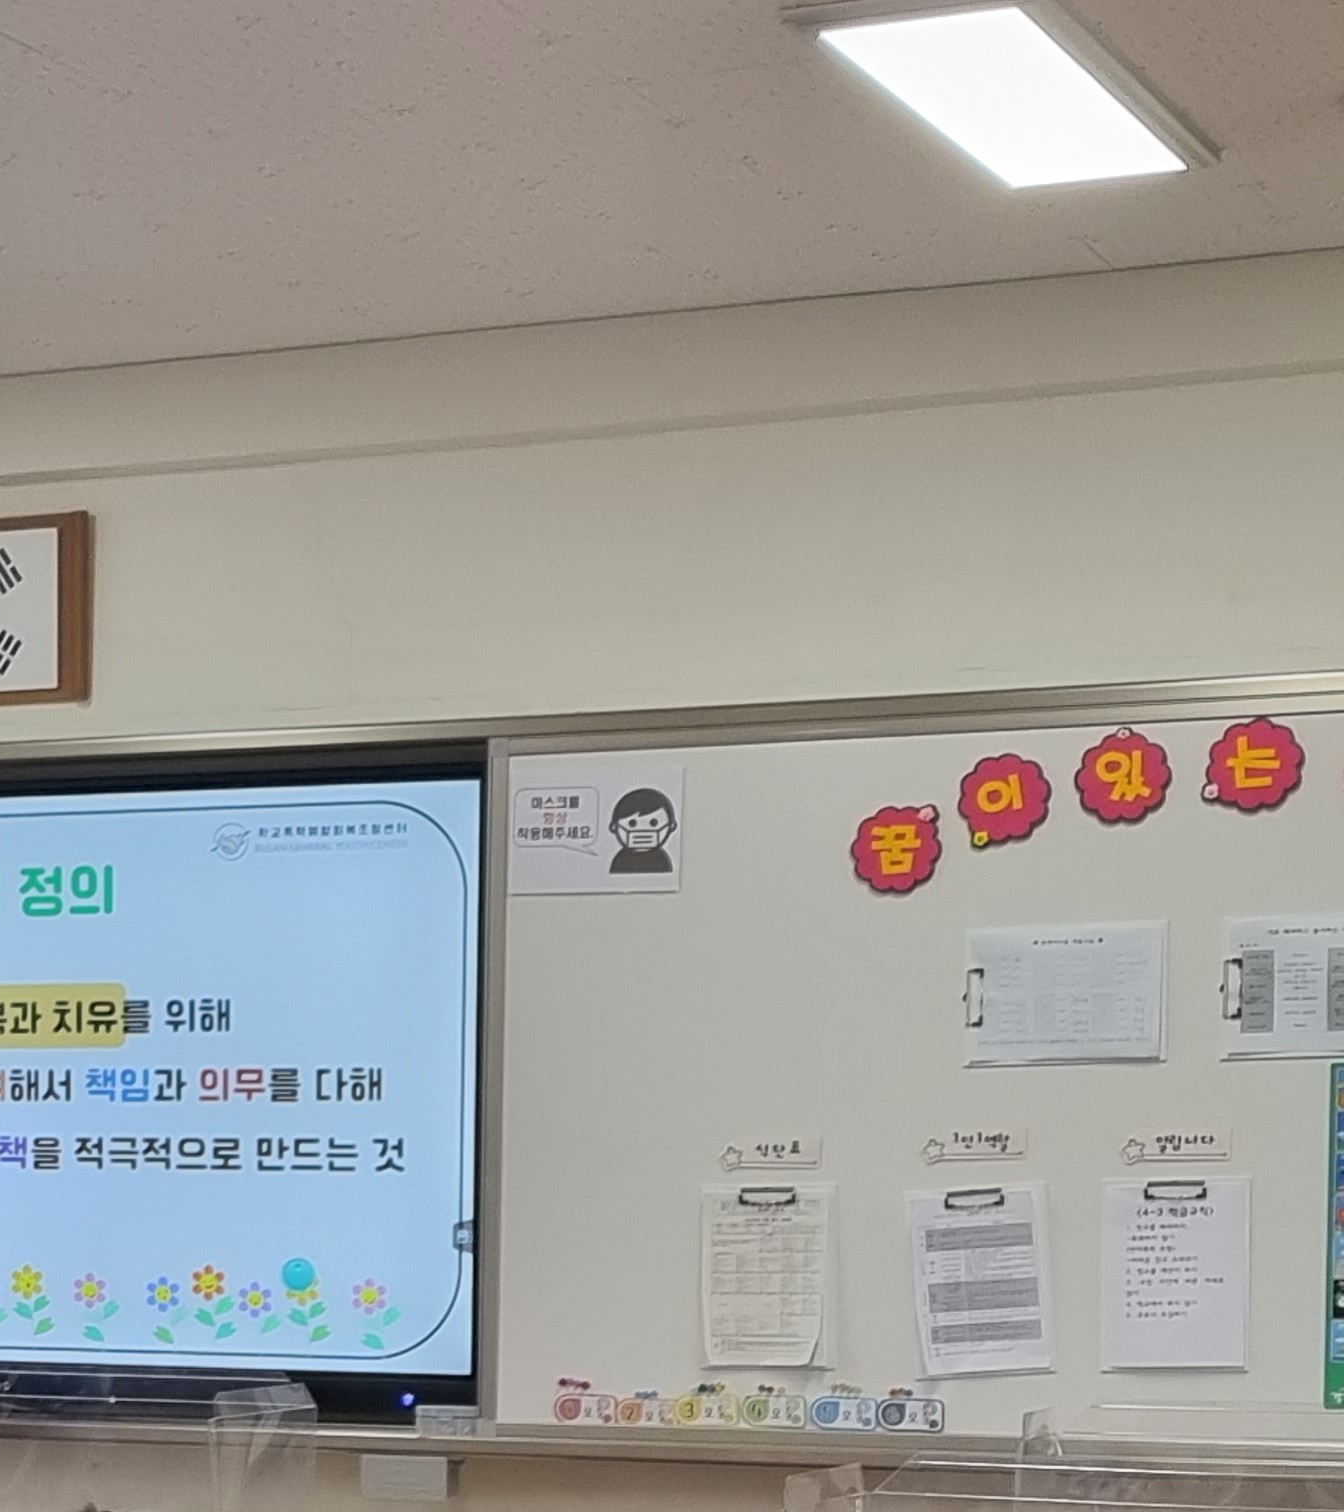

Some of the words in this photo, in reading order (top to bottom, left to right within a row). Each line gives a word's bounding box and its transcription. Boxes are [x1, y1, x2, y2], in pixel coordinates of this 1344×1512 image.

[530, 795, 580, 810] 마스크를
[18, 864, 114, 917] 정의
[52, 999, 152, 1034] 치유를
[165, 997, 232, 1032] 위해
[85, 1067, 187, 1102] 책임과
[198, 1066, 302, 1102] 의무를
[315, 1067, 383, 1101] 다해
[74, 1136, 243, 1170] 적극적으로
[256, 1136, 360, 1172] 만드는
[372, 1136, 406, 1172] 것
[1155, 1134, 1215, 1154] 알립니다
